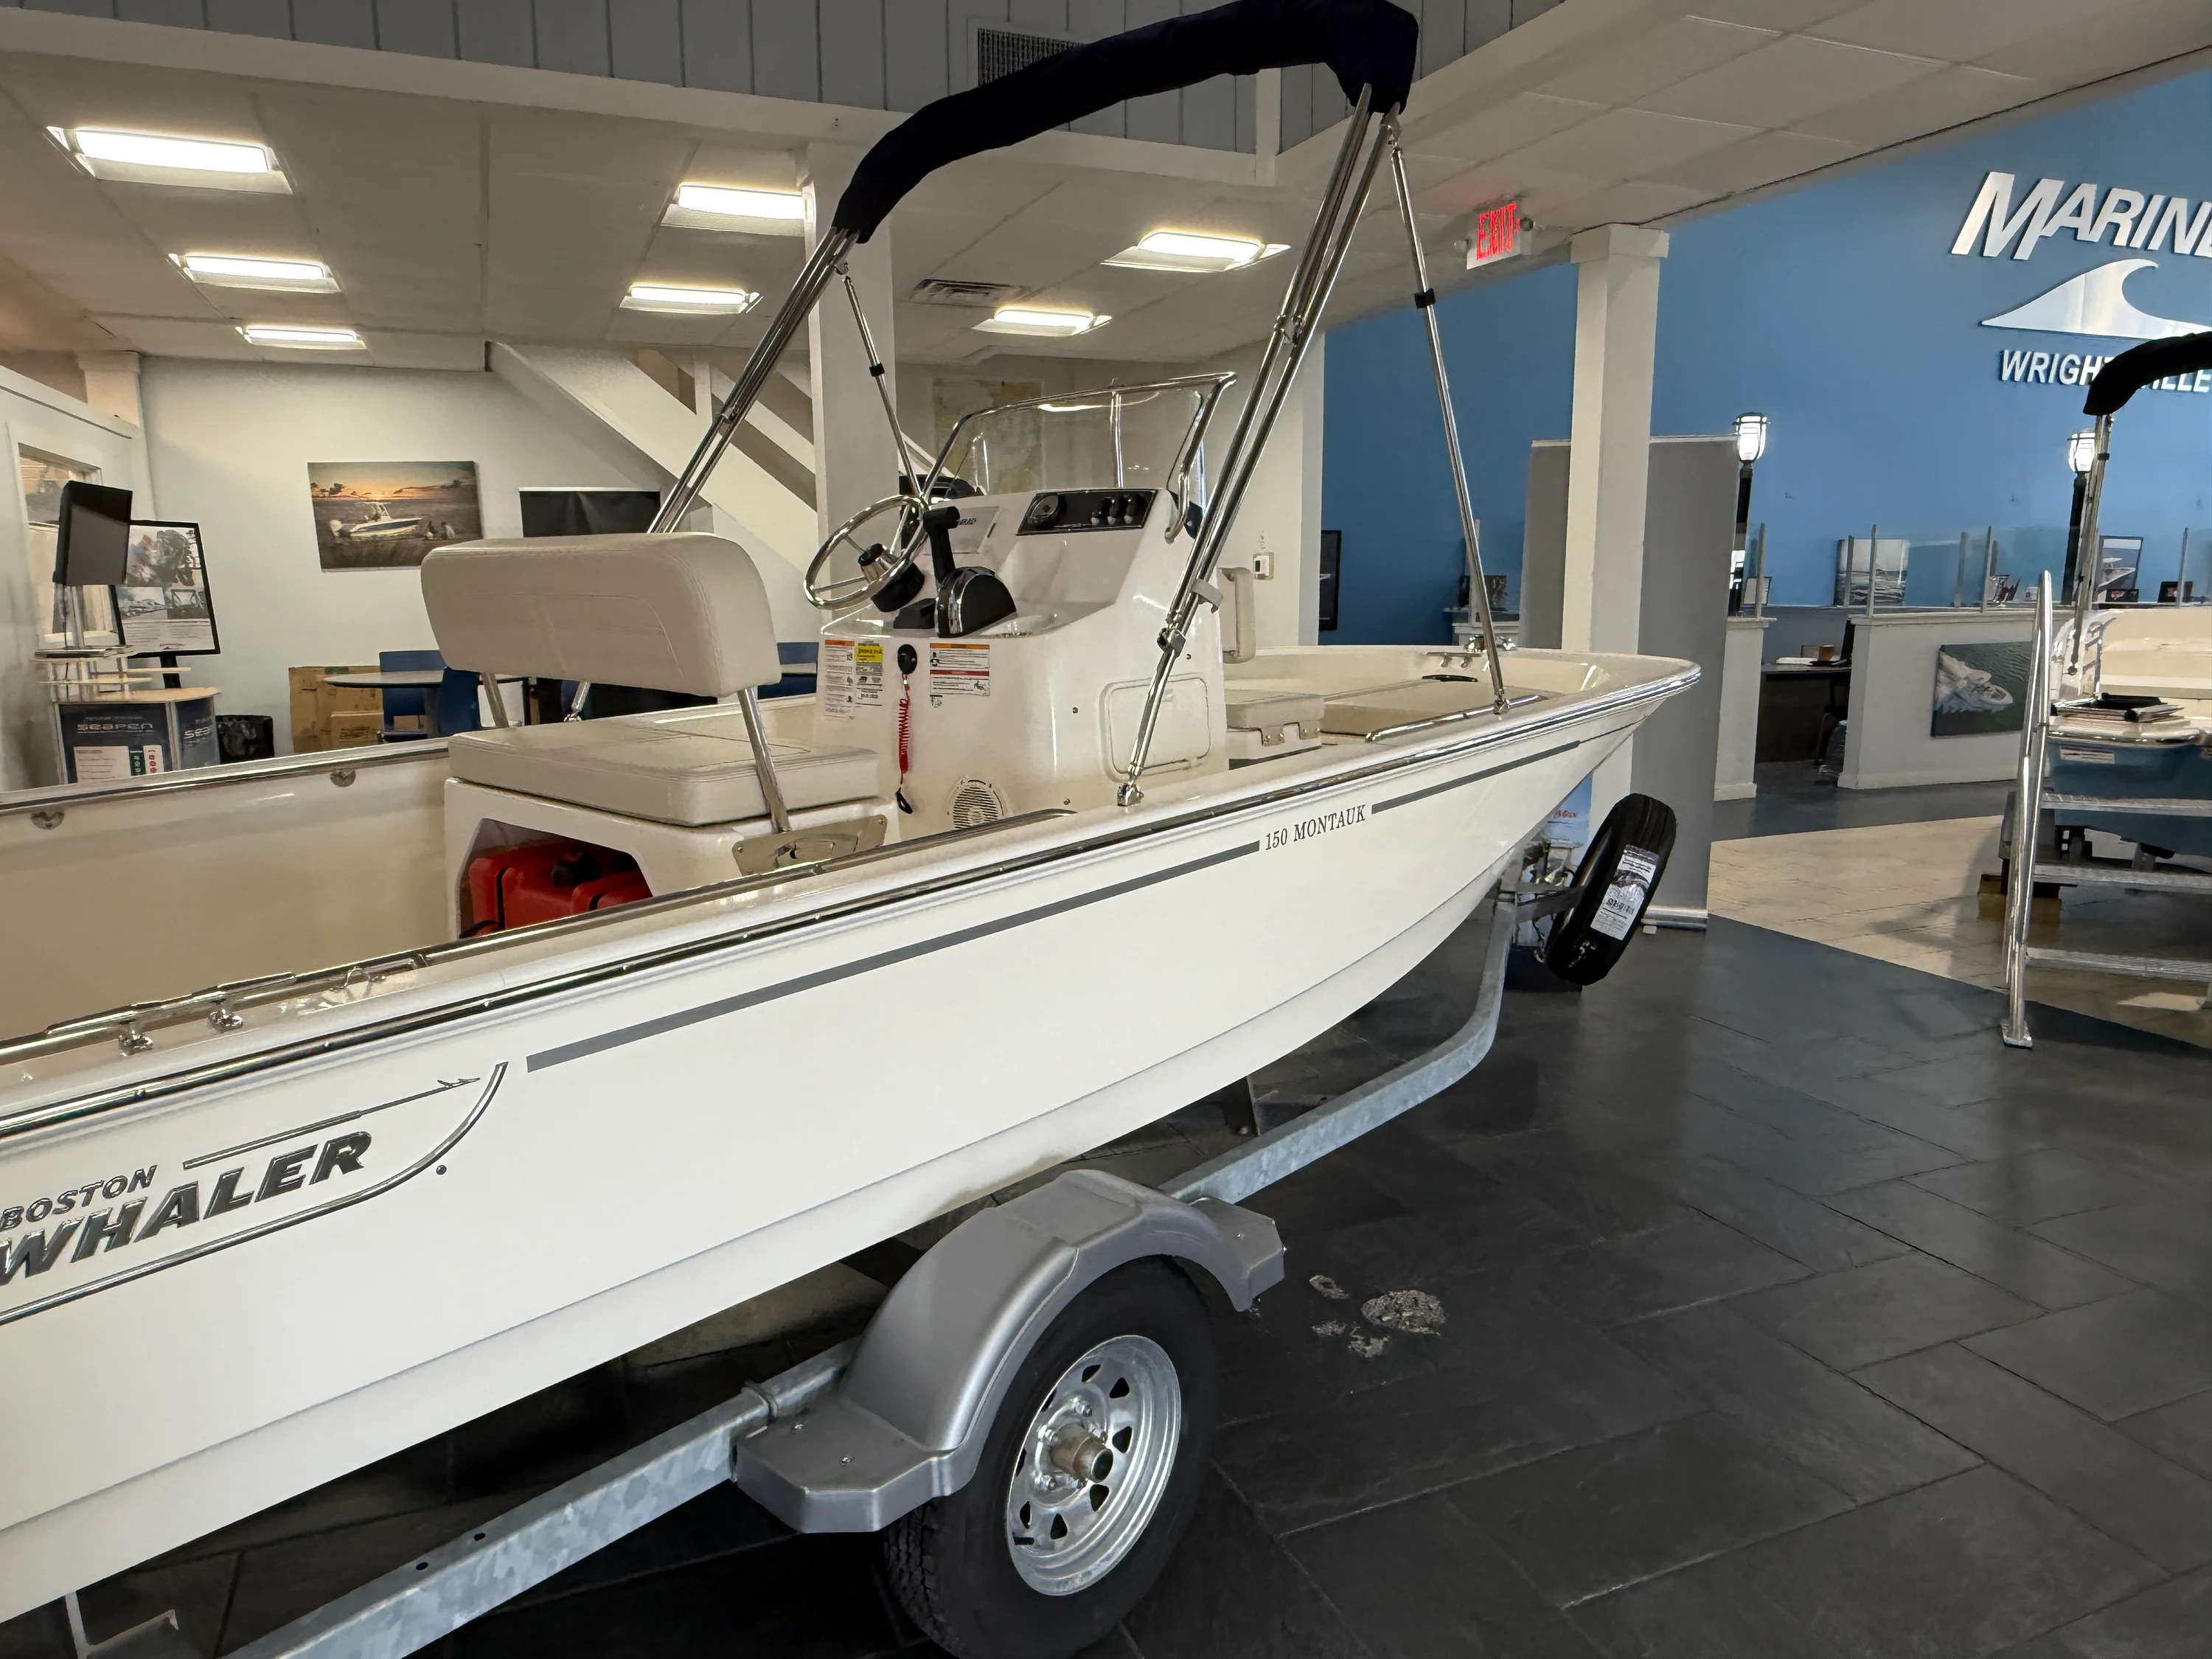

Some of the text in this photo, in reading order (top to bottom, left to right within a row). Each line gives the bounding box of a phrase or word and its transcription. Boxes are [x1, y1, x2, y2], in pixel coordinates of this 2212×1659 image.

[1477, 203, 1517, 260] EXIT
[1265, 804, 1366, 851] 150 MONTAUK
[0, 1165, 158, 1232] BOSTON
[0, 1131, 372, 1287] WHALER
